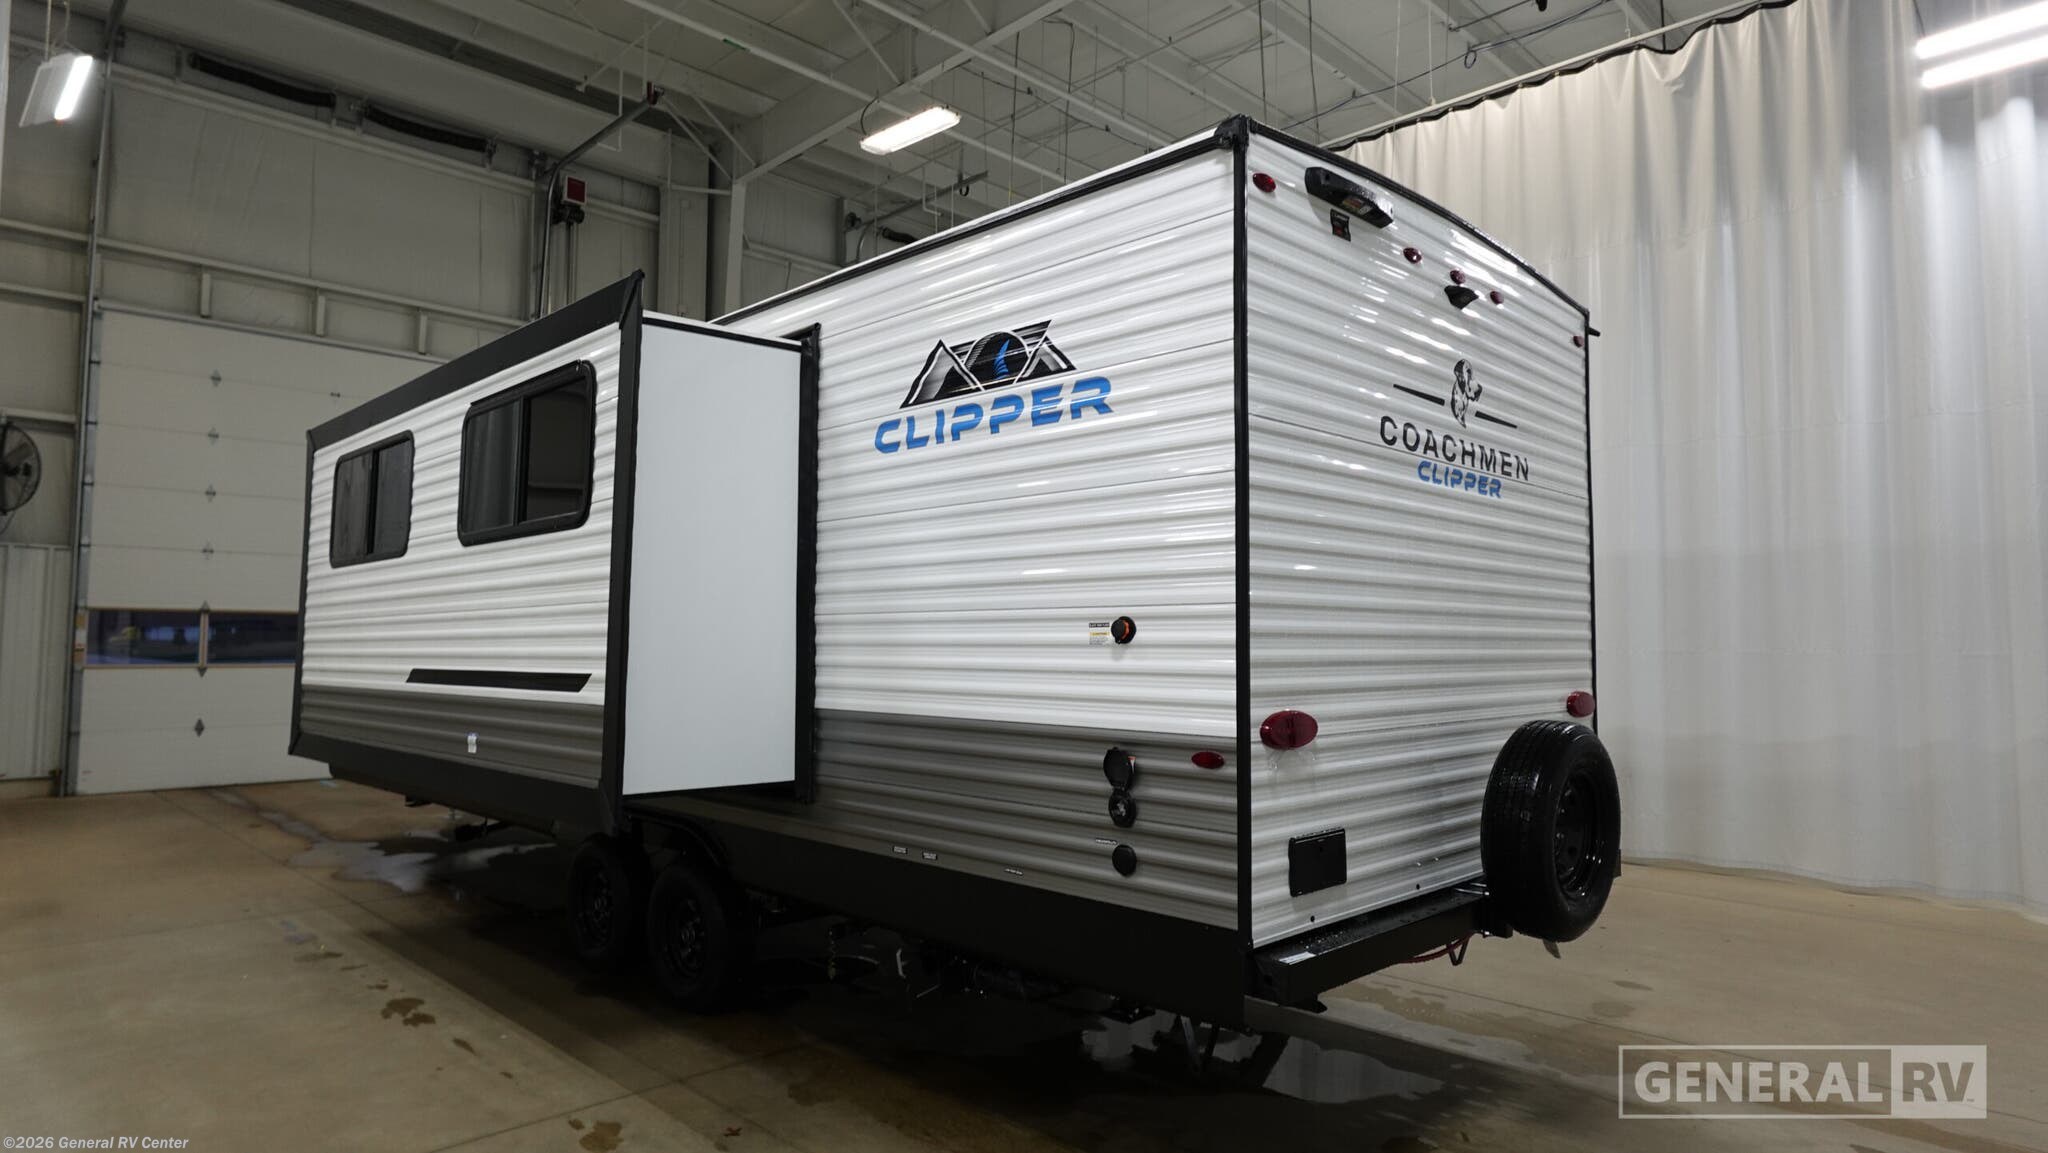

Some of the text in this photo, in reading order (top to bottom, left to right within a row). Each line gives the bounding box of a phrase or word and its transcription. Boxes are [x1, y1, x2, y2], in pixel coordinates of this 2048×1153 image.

[875, 376, 1113, 454] CLIPPER
[1380, 416, 1529, 481] COACHMEN
[1418, 460, 1502, 499] CLIPPER
